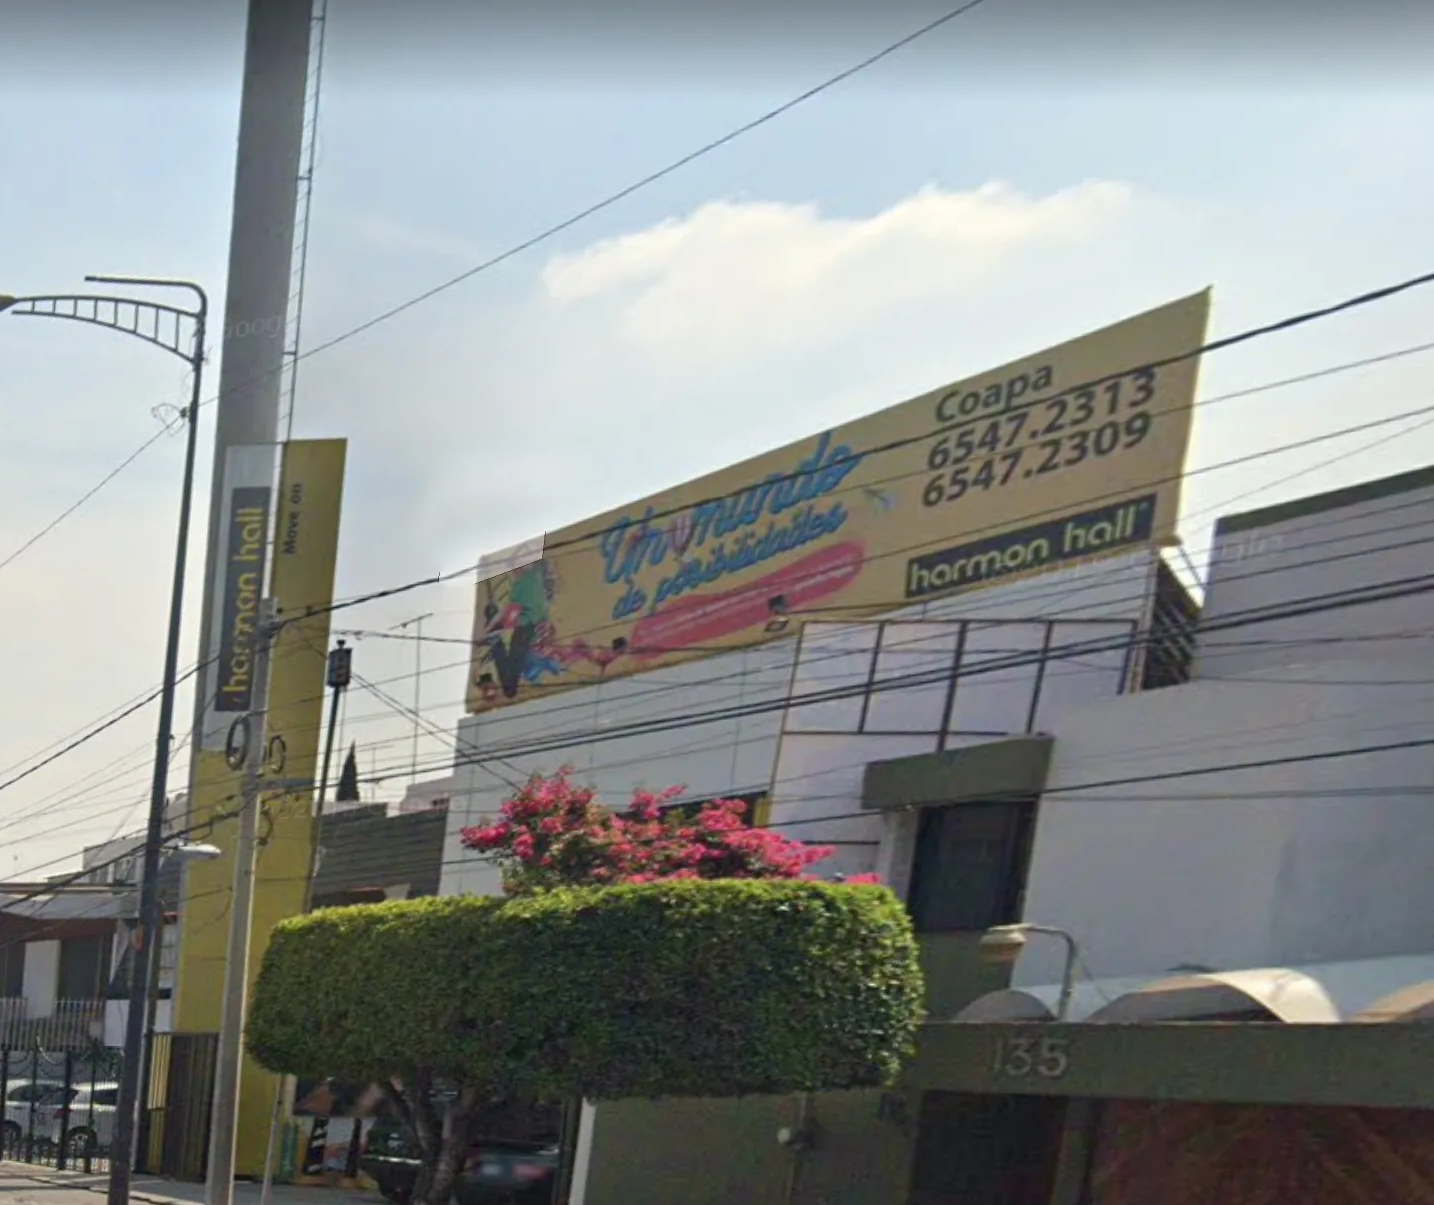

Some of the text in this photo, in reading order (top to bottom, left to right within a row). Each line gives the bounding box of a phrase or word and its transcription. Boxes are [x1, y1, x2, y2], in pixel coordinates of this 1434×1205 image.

[927, 366, 1156, 471] 6547.2313
[935, 364, 1054, 423] Coapa
[693, 430, 863, 547] mundo
[921, 410, 1151, 507] 6547.2309
[283, 483, 301, 554] Move on
[908, 504, 1137, 591] harmon hall
[221, 506, 264, 693] harmon hall
[992, 1038, 1068, 1078] 135
